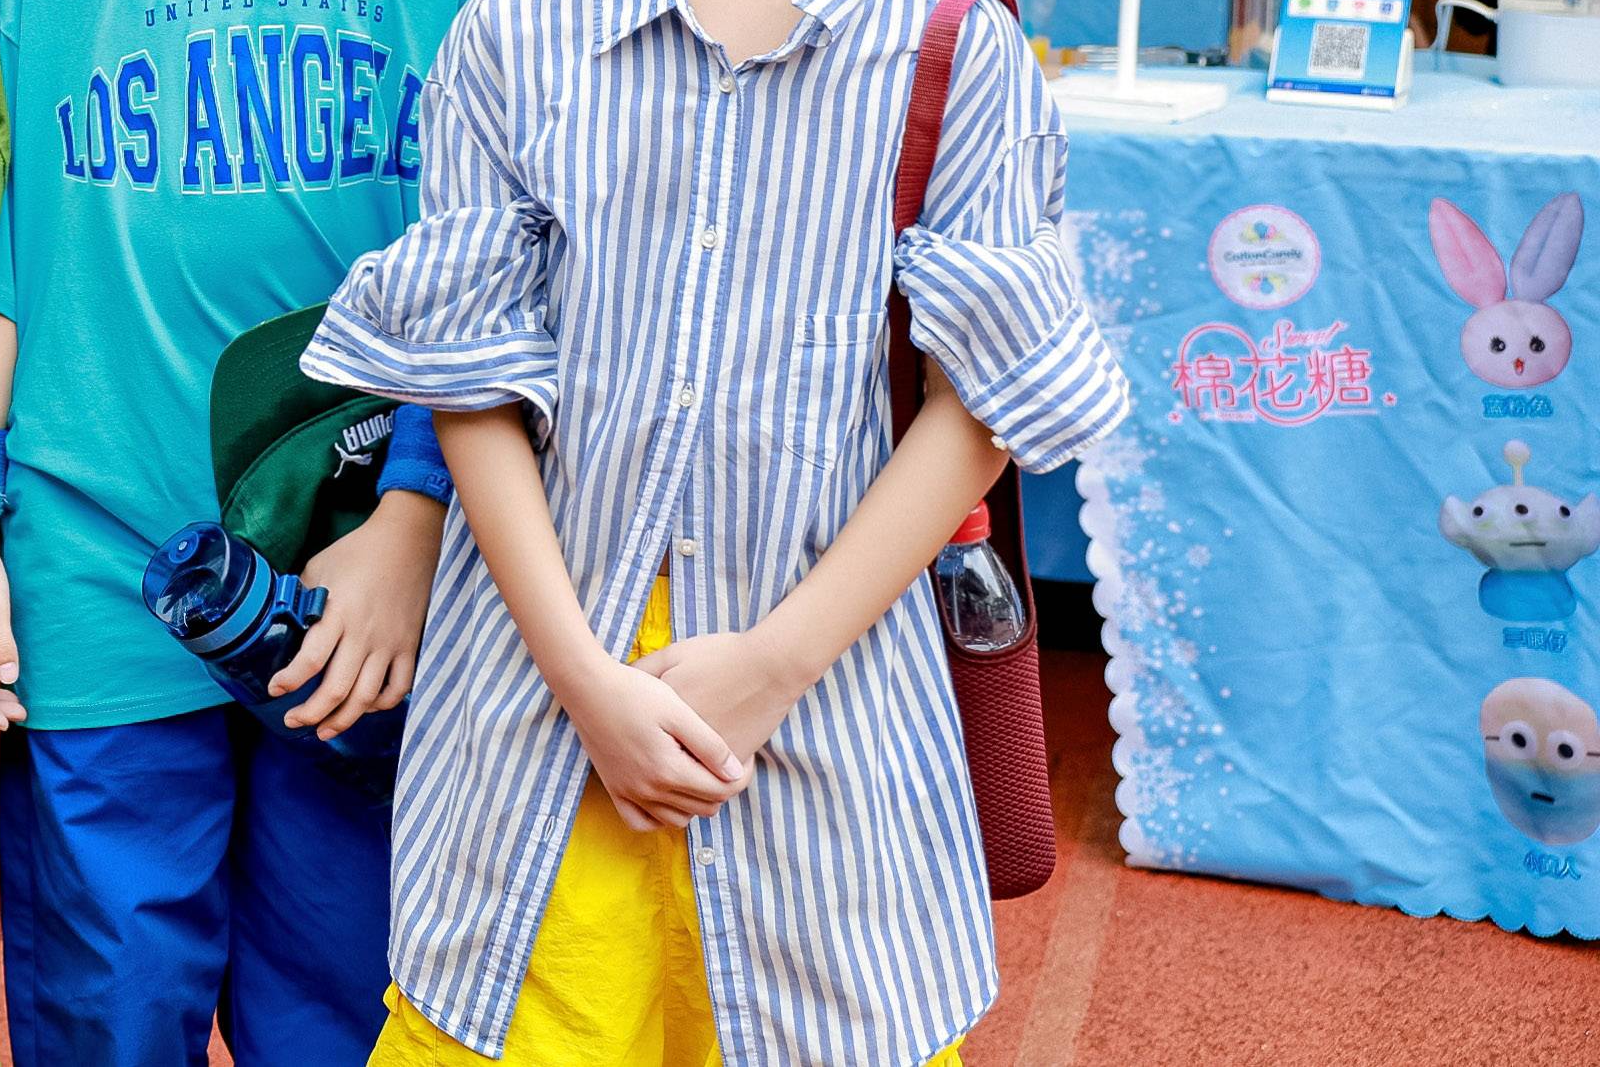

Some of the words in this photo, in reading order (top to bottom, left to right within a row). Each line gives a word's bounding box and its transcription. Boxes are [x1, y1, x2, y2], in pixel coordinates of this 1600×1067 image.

[55, 49, 160, 192] LOS
[1172, 344, 1372, 411] 棉花糖
